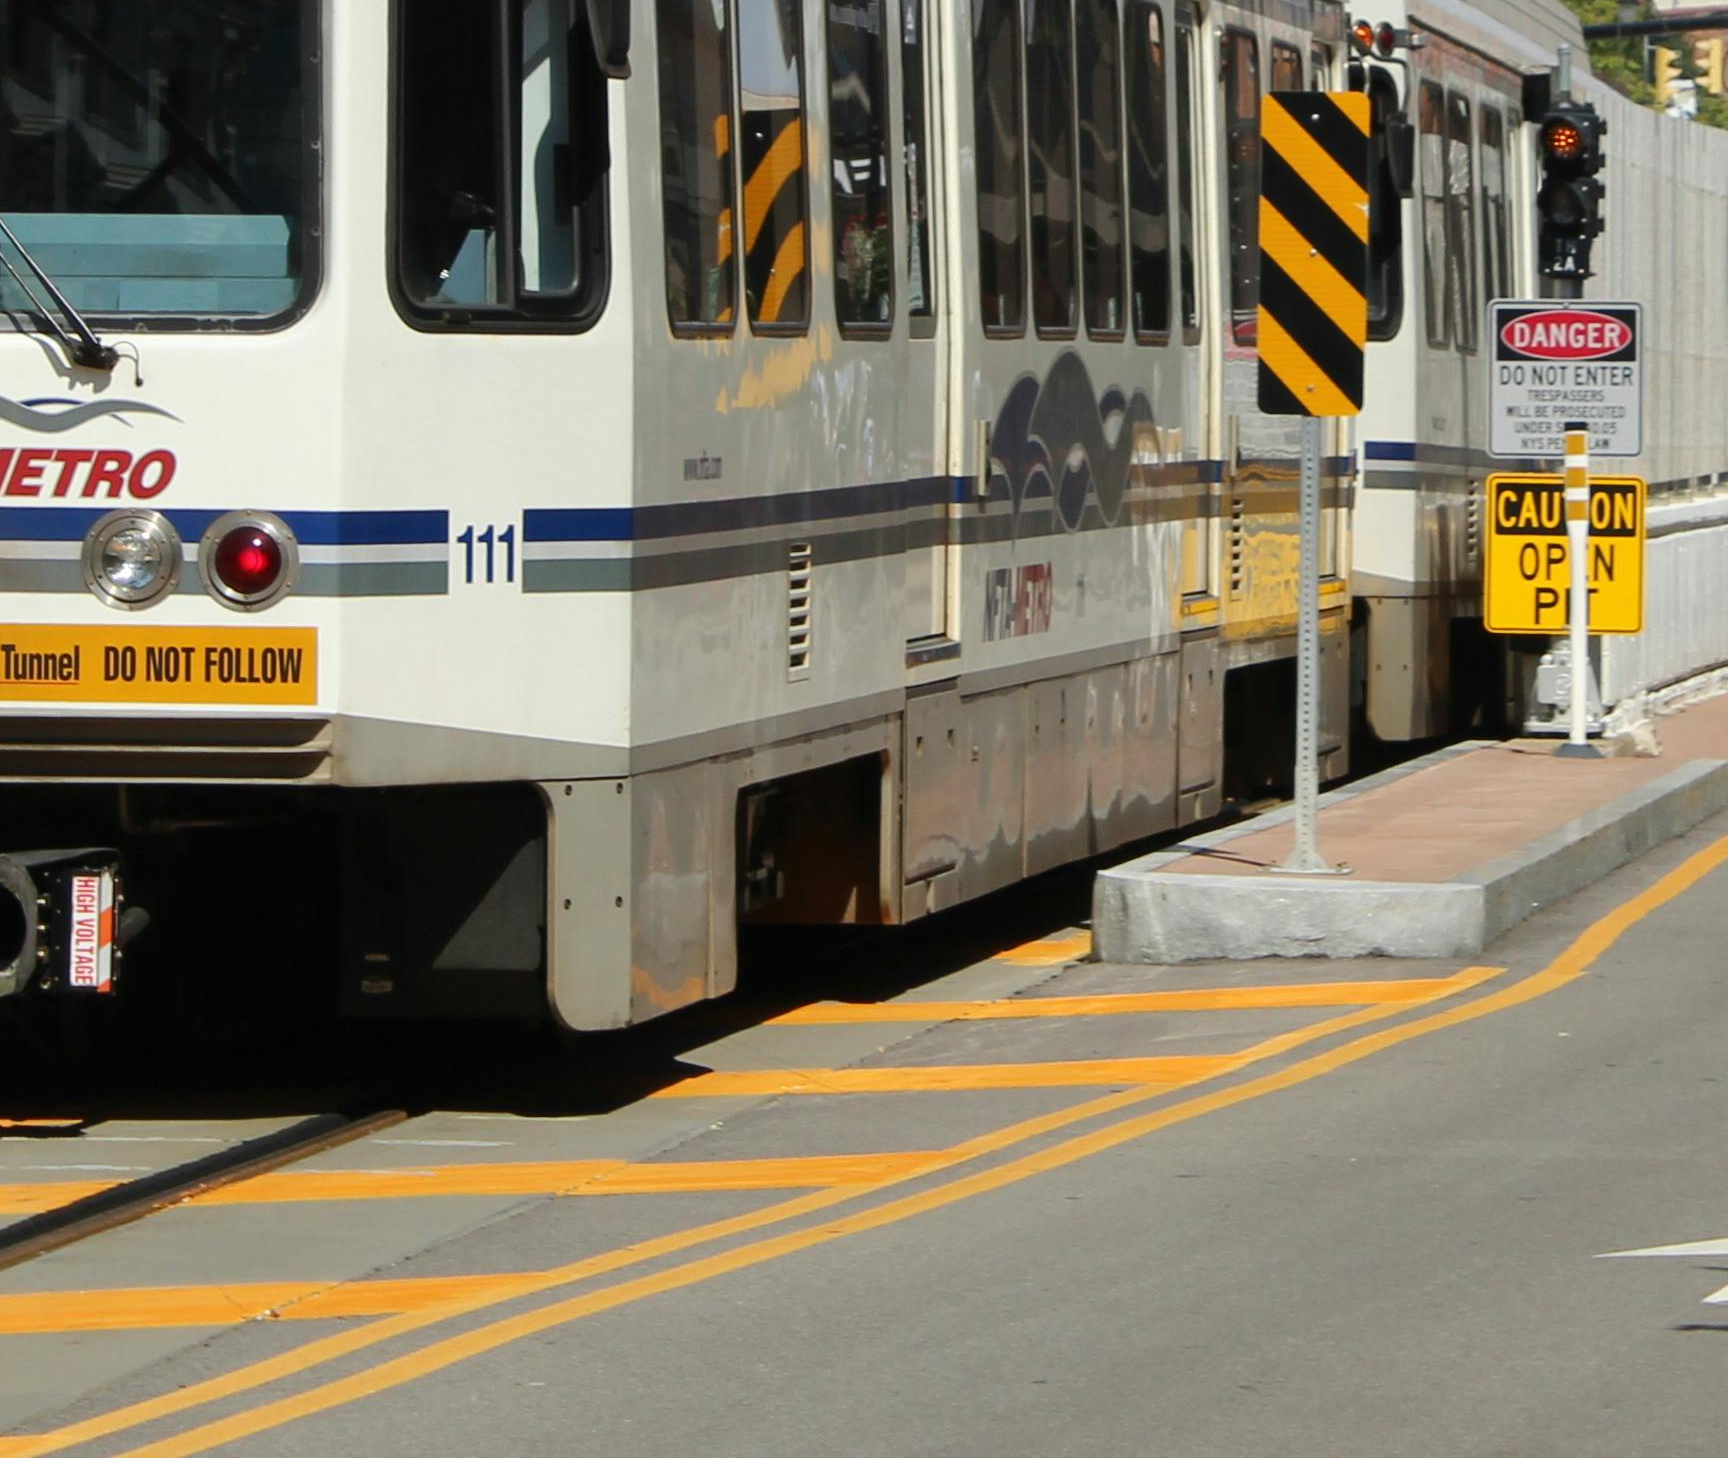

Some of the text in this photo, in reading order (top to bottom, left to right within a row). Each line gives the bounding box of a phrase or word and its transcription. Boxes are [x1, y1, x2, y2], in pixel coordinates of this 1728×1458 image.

[1513, 322, 1622, 349] DANGER
[1499, 366, 1633, 387] DO NOT ENTER
[1527, 389, 1605, 402] TRESPASSERS
[1506, 405, 1626, 418] WILL BE PROSECUTED
[1515, 421, 1553, 434] UNDER
[1521, 437, 1544, 450] NYS
[1497, 490, 1635, 530] CAUON
[454, 522, 516, 585] 111
[1519, 542, 1616, 582] OPN
[0, 642, 80, 683] Tunnel
[103, 644, 139, 683] DO
[144, 644, 194, 684] NOT
[203, 646, 303, 685] FOLLOW
[72, 877, 96, 986] HIGH VOLTAGE
